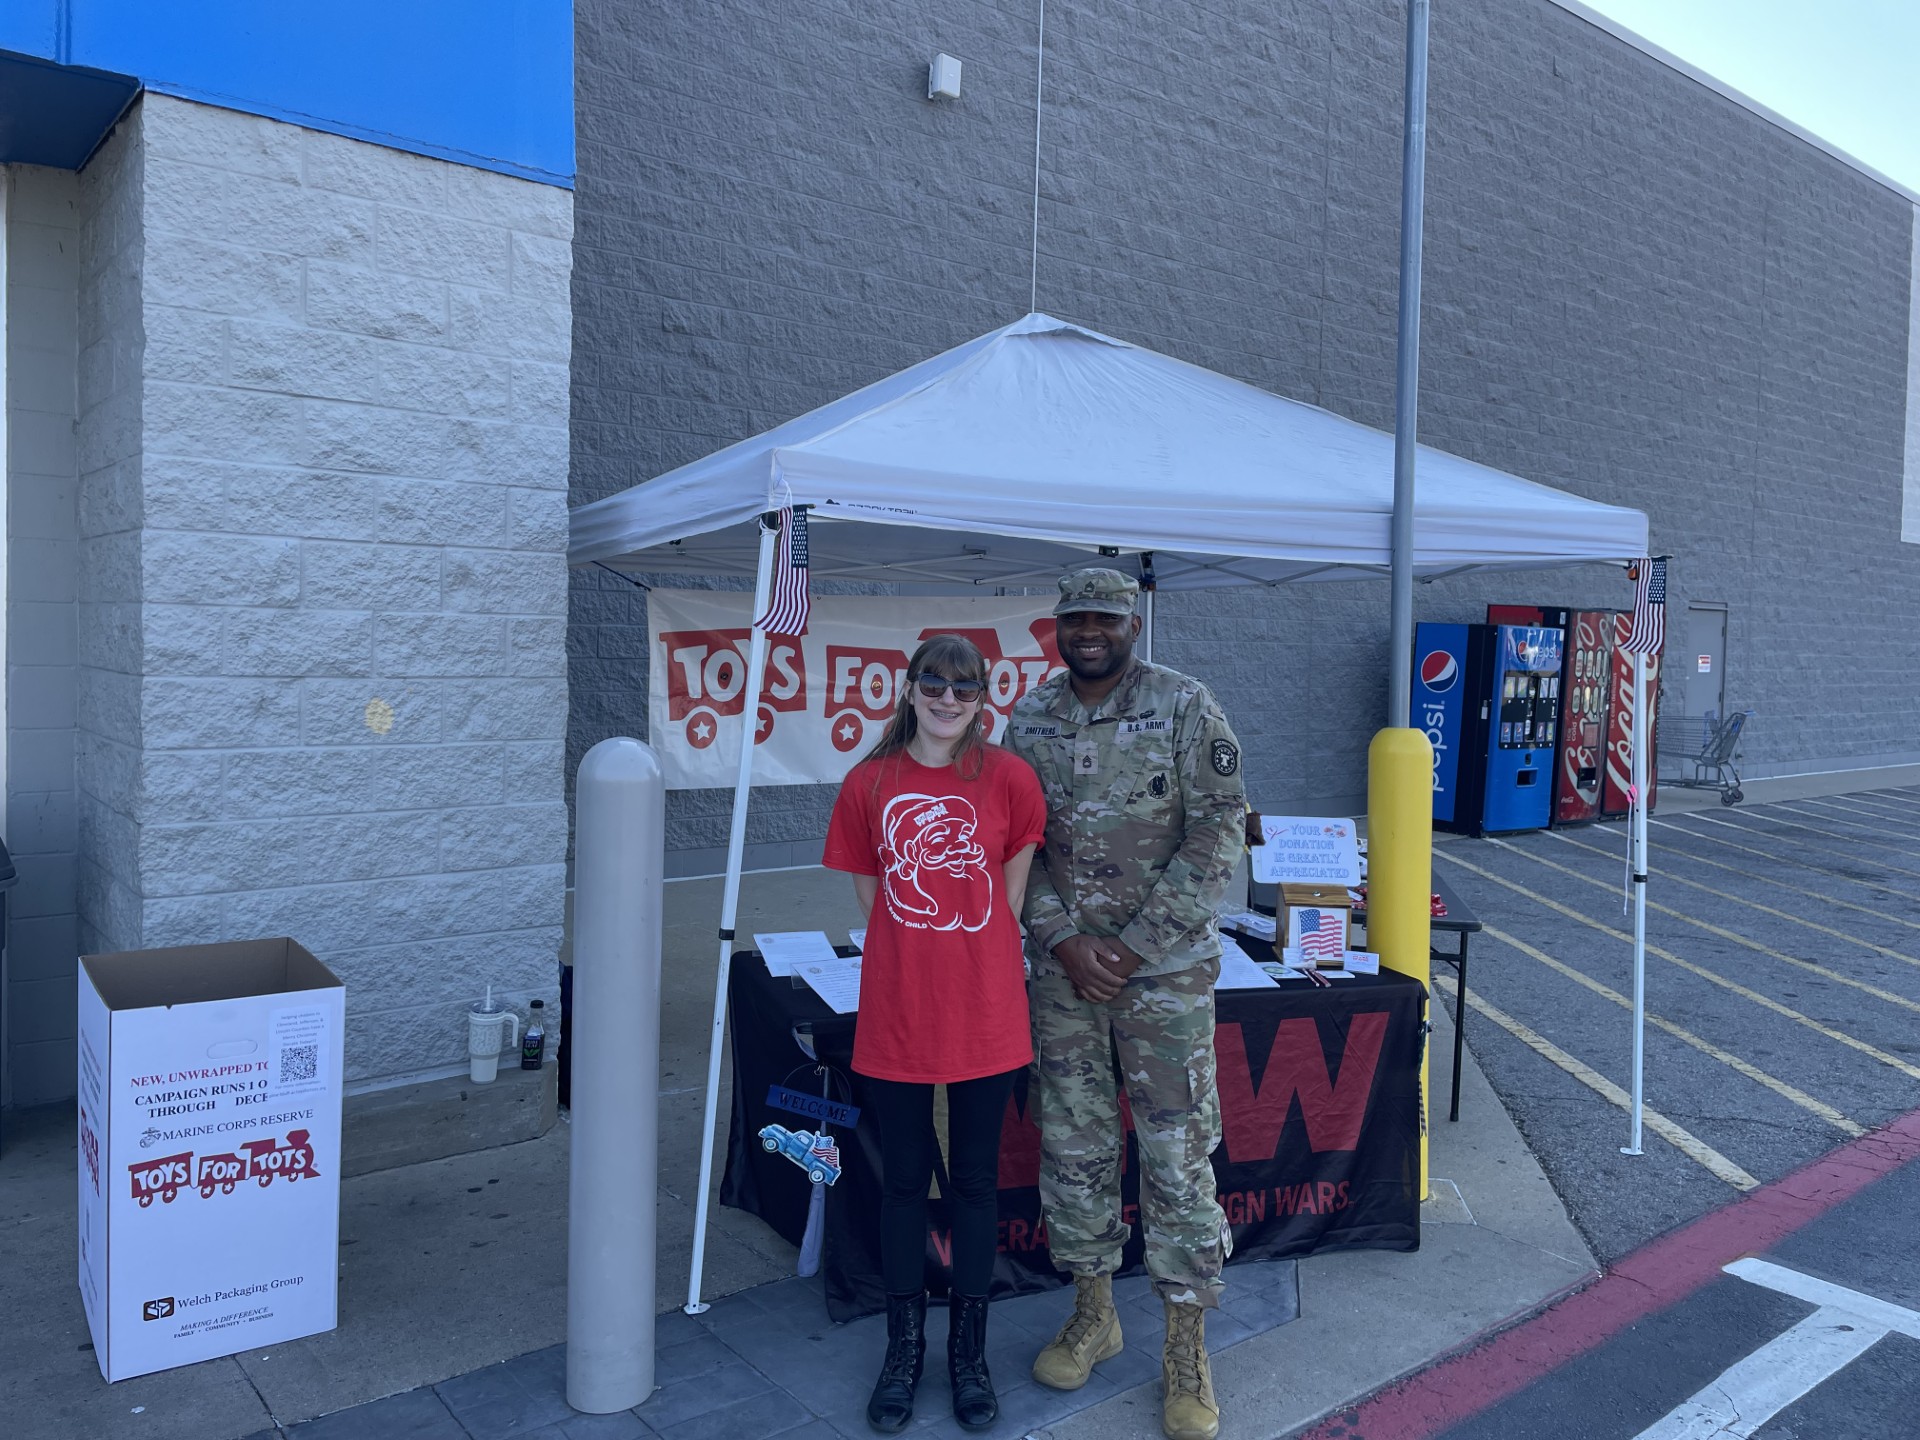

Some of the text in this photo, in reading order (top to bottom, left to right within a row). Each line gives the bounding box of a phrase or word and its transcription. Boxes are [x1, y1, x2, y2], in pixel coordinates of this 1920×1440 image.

[984, 658, 1071, 707] OT
[1127, 720, 1166, 733] U.S. ARMY
[1291, 824, 1321, 836] YOUR
[1279, 839, 1335, 849] DONATION
[1273, 852, 1342, 864] IS GREATLY
[1269, 866, 1349, 879] APPRECIATED
[905, 920, 928, 929] CHILD
[130, 1075, 166, 1088] NEW,
[168, 1062, 252, 1083] UNWRAPPED
[134, 1087, 208, 1106] CAMPAIGN
[211, 1082, 246, 1096] RUNS
[249, 1080, 254, 1090] 1
[147, 1100, 216, 1118] THROUGH
[779, 1091, 848, 1122] WELCOME
[162, 1108, 314, 1141] MARINE CORPS RESERVE
[134, 1148, 306, 1191] TOYS FOR TOTS
[177, 1276, 304, 1309] Welch Packaging Group
[173, 1312, 274, 1338] FAMILY COMMUNITY BUSINESS
[180, 1306, 269, 1331] MAKING A DIFFERENCE
